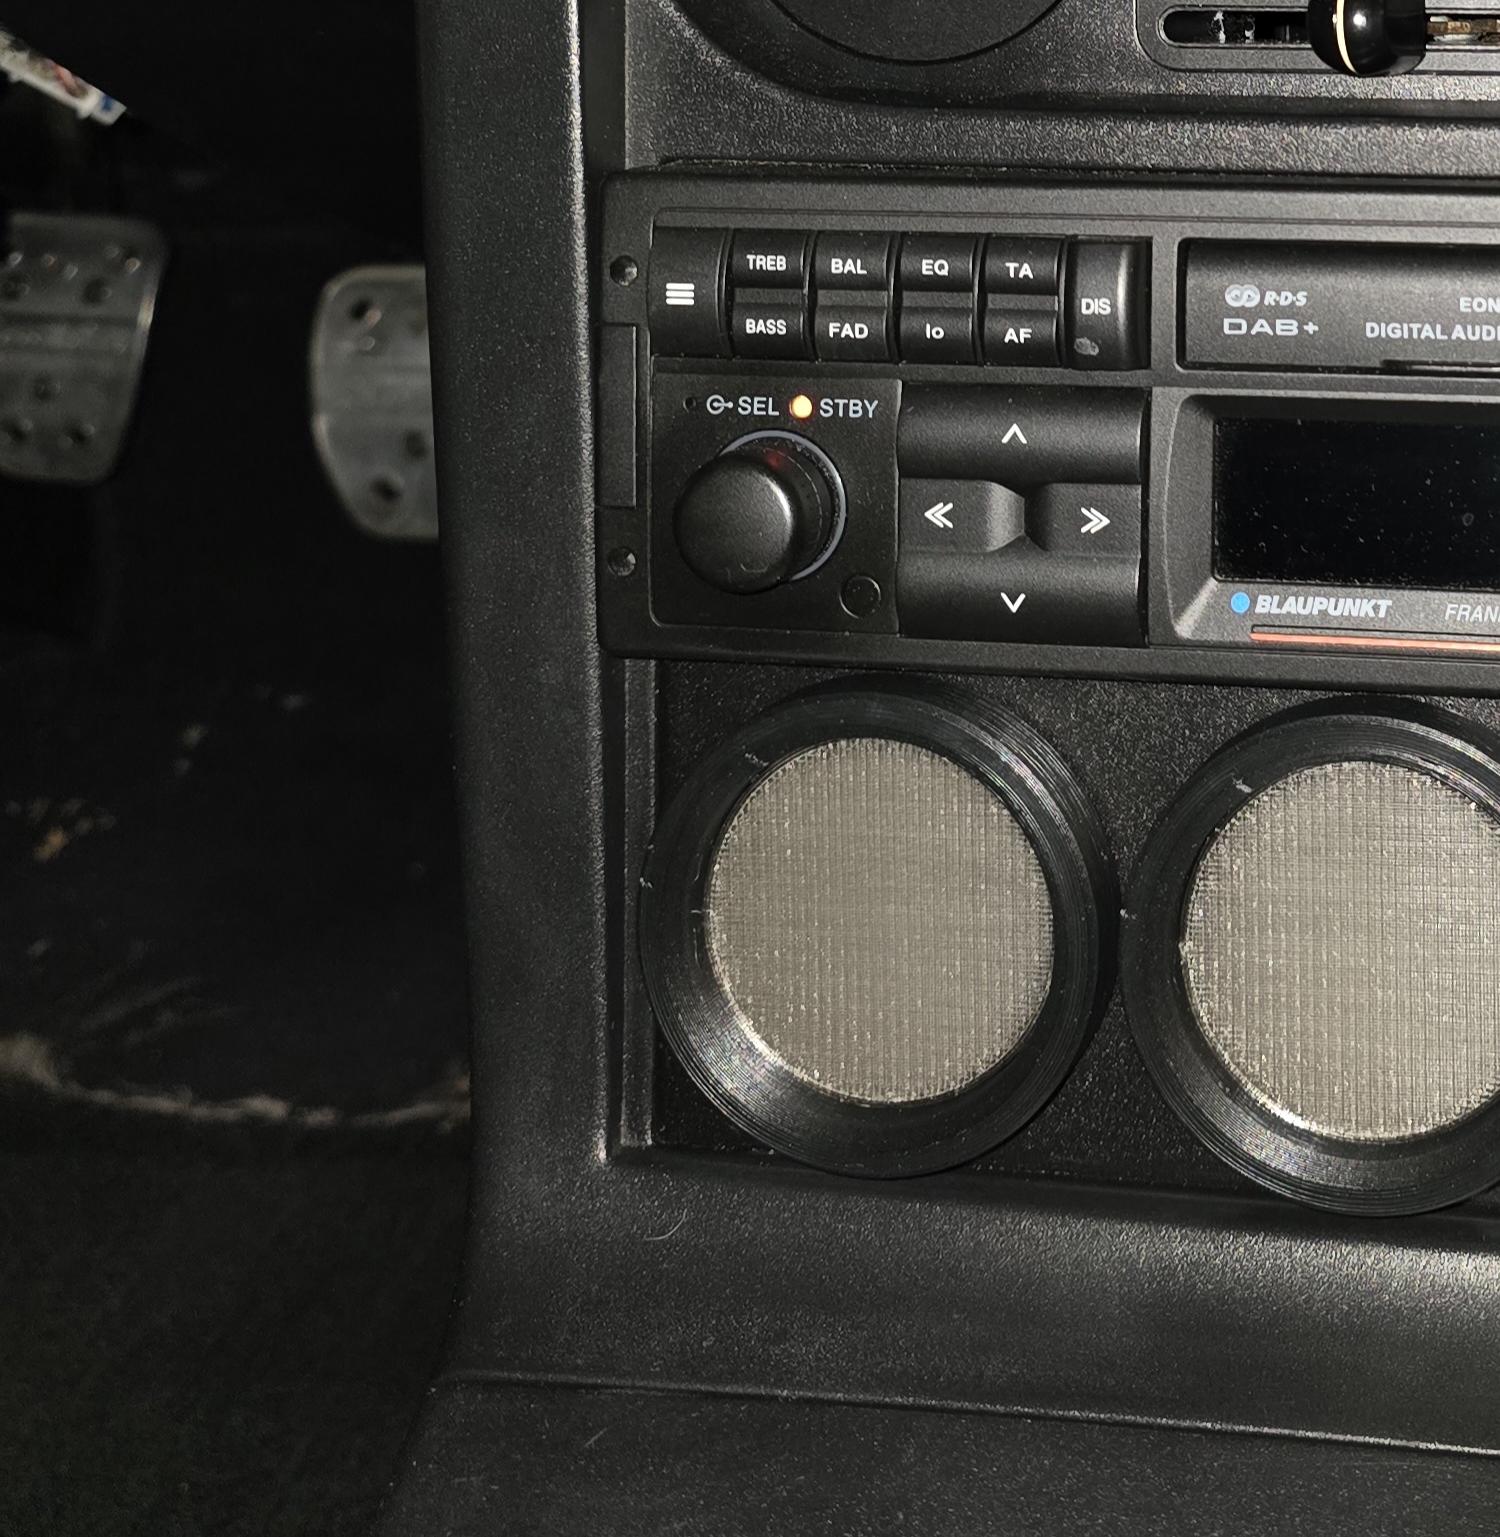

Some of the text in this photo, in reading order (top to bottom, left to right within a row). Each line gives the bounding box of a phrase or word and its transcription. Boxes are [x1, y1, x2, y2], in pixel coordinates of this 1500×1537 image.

[746, 254, 786, 271] TREB
[831, 257, 866, 274] BAL
[921, 259, 949, 276] EQ
[1006, 263, 1033, 279] TA
[1081, 297, 1111, 315] DIS
[1459, 297, 1500, 313] EON
[745, 318, 786, 335] BASS
[828, 322, 868, 339] FAD
[1223, 317, 1319, 336] DAB+
[1365, 321, 1448, 339] DIGITAL
[1004, 328, 1031, 343] AF
[737, 397, 779, 415] SEL
[819, 399, 877, 418] STBY
[1255, 595, 1391, 618] BLAUPUNKT
